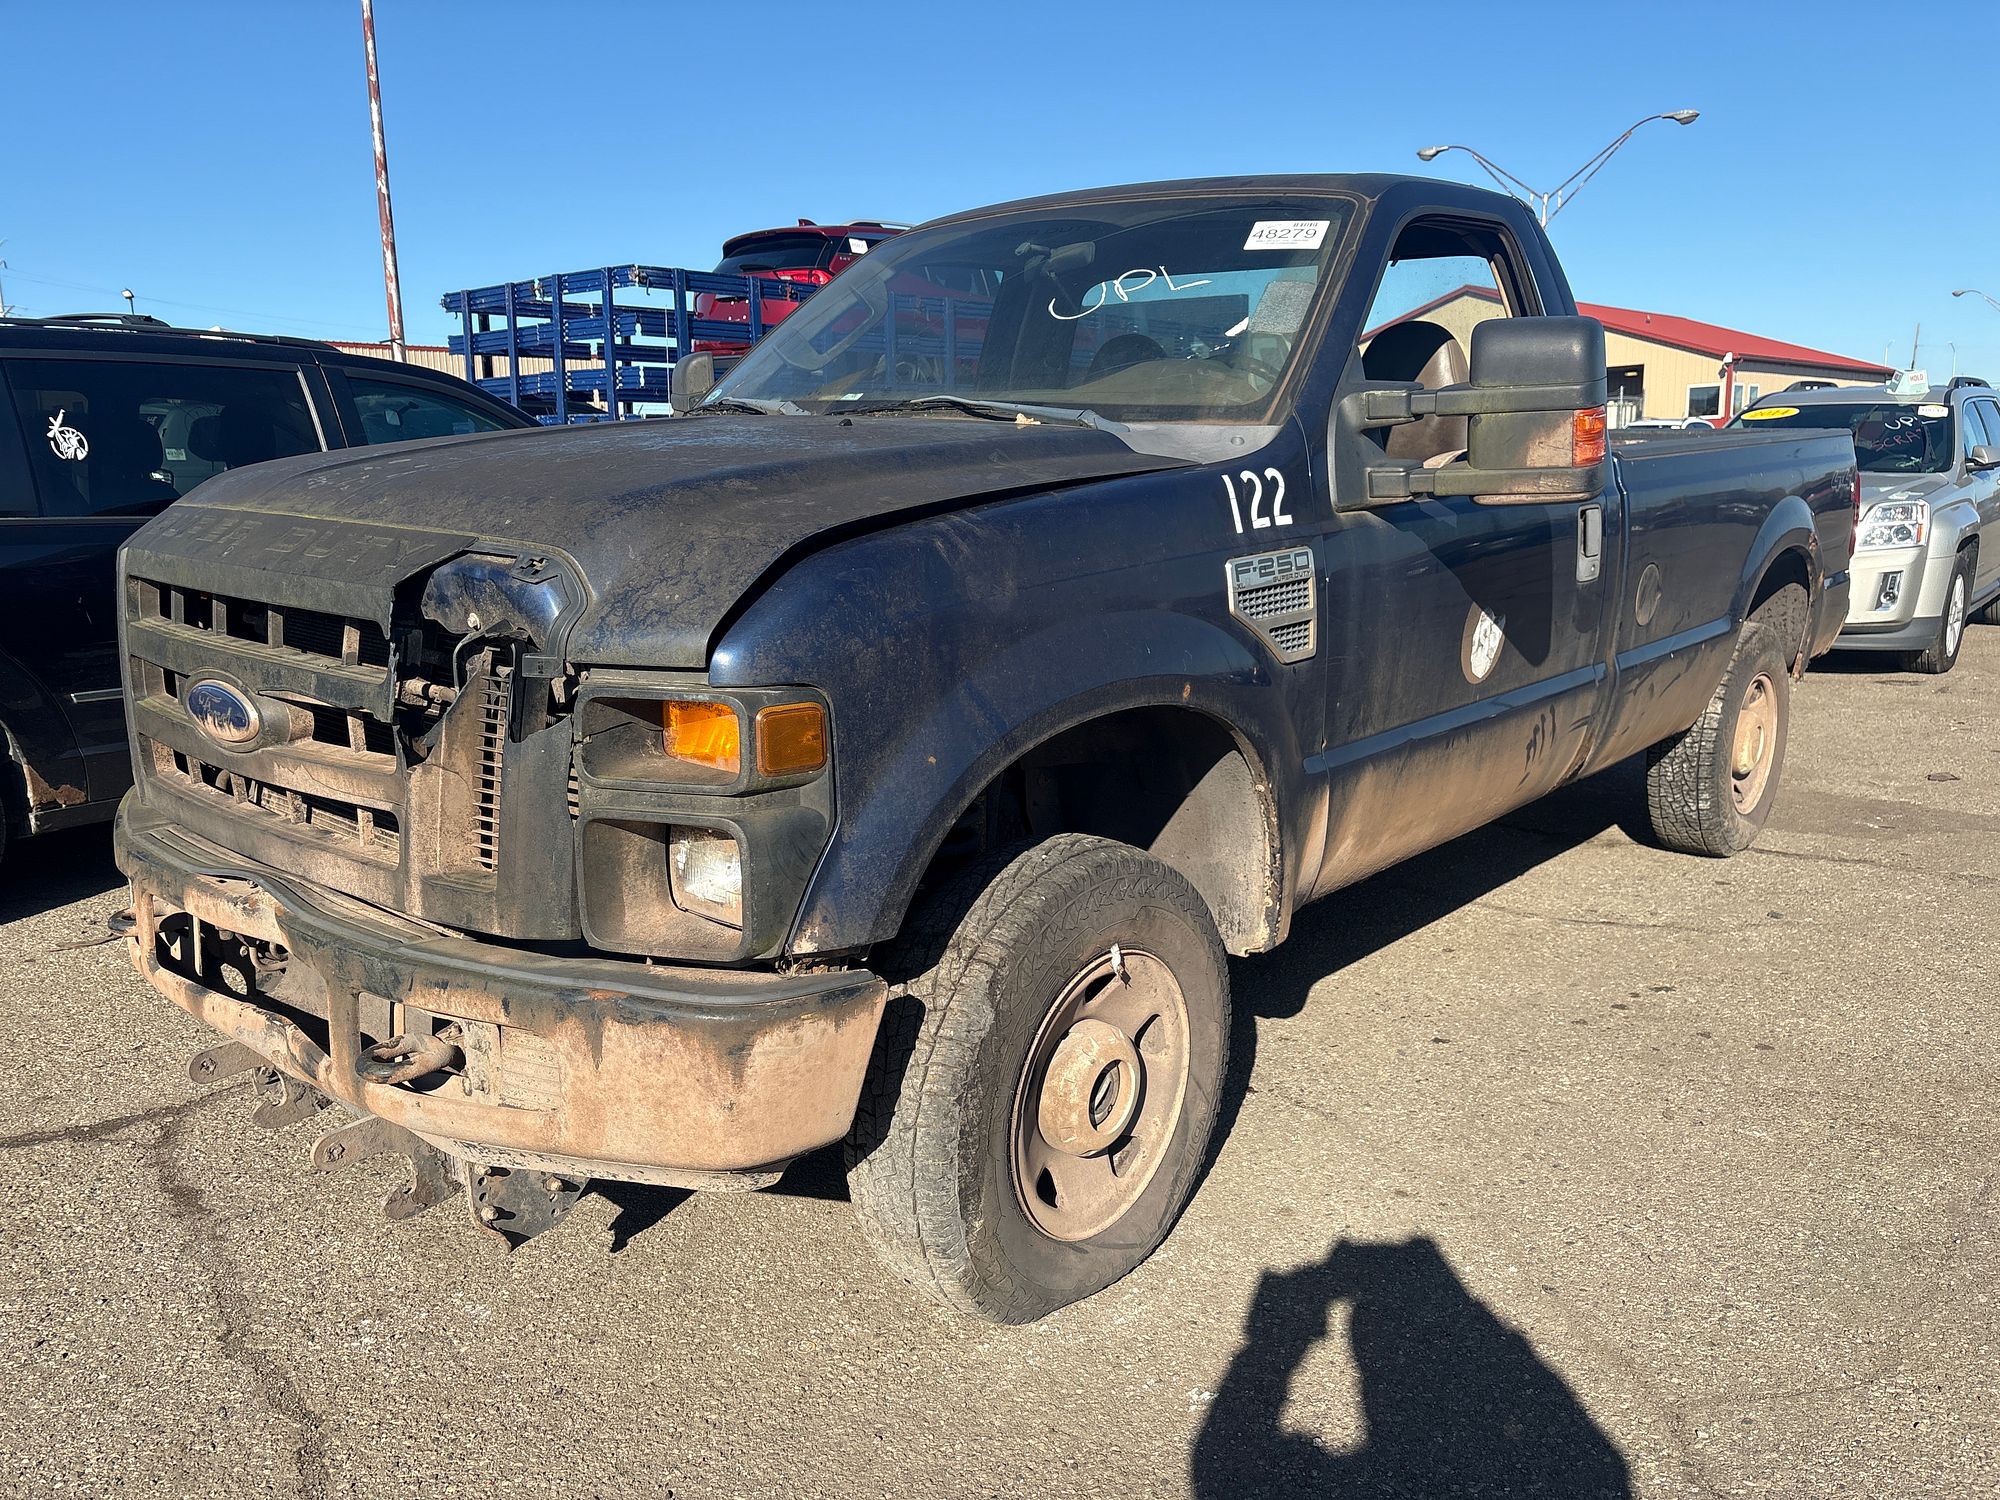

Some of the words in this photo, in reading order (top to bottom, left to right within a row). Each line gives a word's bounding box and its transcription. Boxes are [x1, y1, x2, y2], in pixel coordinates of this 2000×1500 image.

[1252, 228, 1317, 239] 48279
[1221, 467, 1293, 534] 122
[1234, 551, 1310, 583] F-250
[1272, 573, 1294, 583] SUPER
[1294, 570, 1312, 579] DUTY
